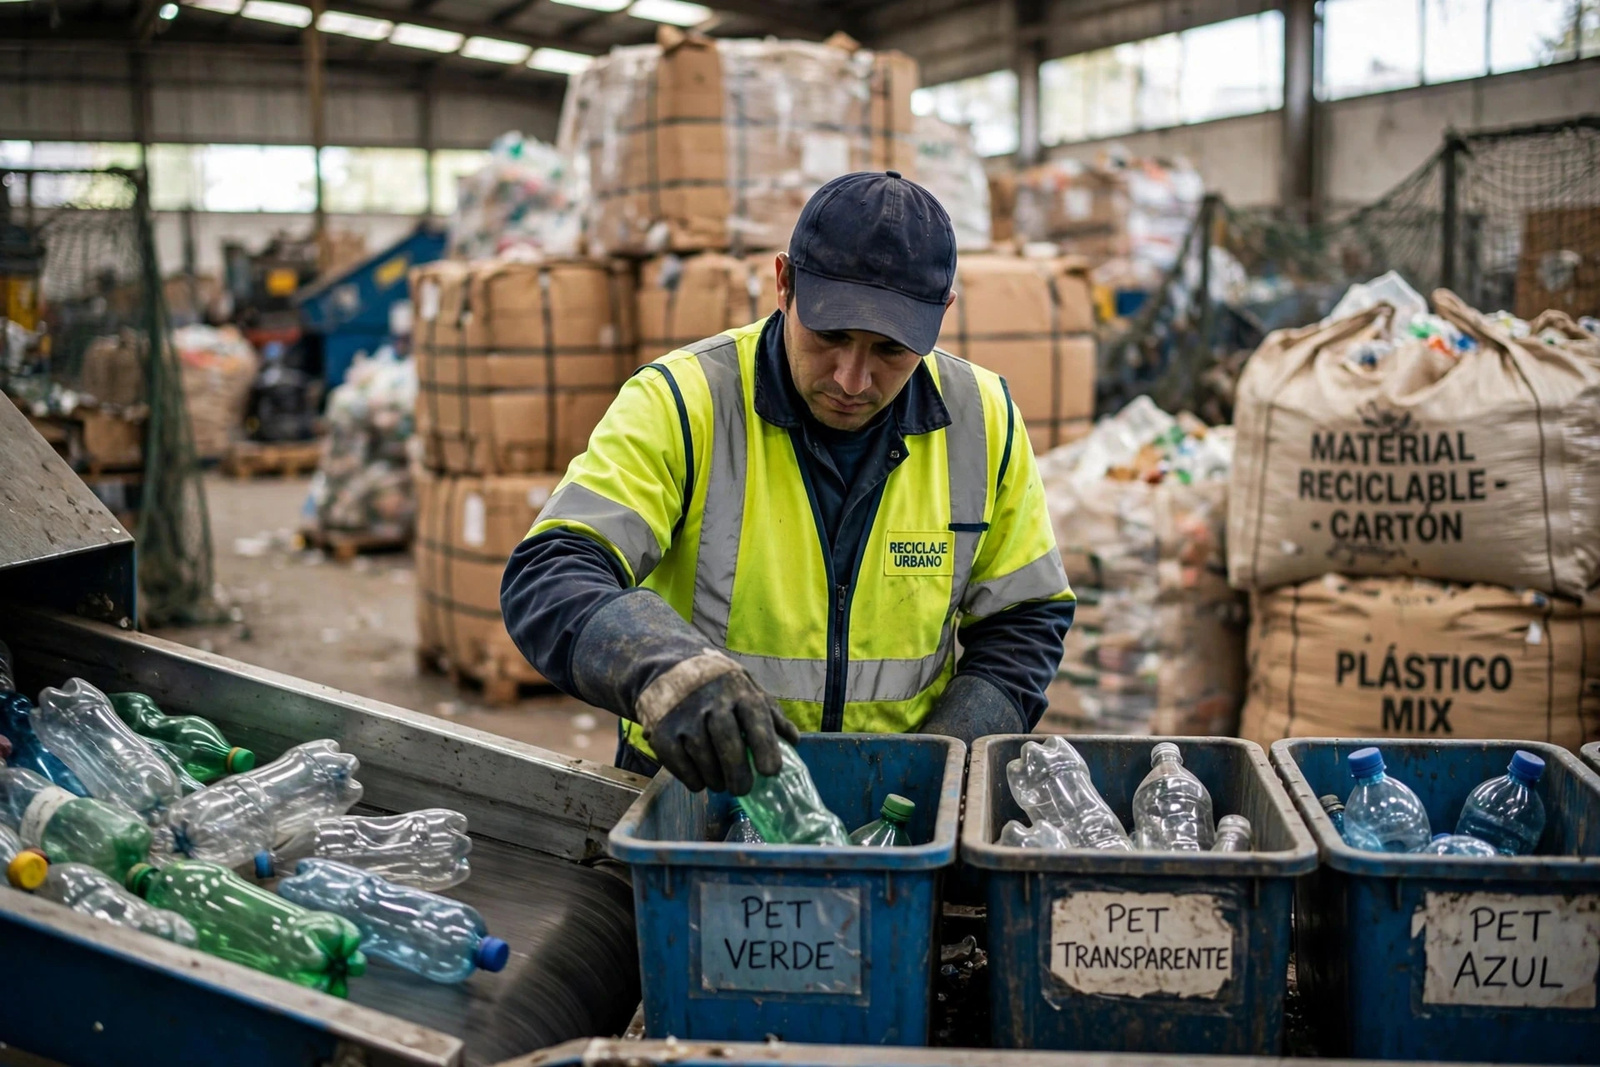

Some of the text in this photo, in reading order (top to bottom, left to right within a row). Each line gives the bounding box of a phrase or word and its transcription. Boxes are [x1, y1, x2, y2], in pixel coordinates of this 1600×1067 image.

[1310, 430, 1475, 465] MATERIAL
[1299, 468, 1487, 503] RECICLABLE
[1330, 502, 1462, 543] CARTÓN
[889, 541, 947, 554] RECICLAJE
[894, 555, 942, 567] URBANO
[1336, 642, 1514, 693] PLÁSTICO
[1381, 696, 1454, 734] MIX
[741, 896, 812, 929] PET
[1105, 903, 1170, 933] PET
[1469, 906, 1552, 942] PET
[724, 938, 835, 970] VERDE
[1056, 941, 1229, 970] TRANSPARENTE
[1453, 951, 1564, 988] AZUL
